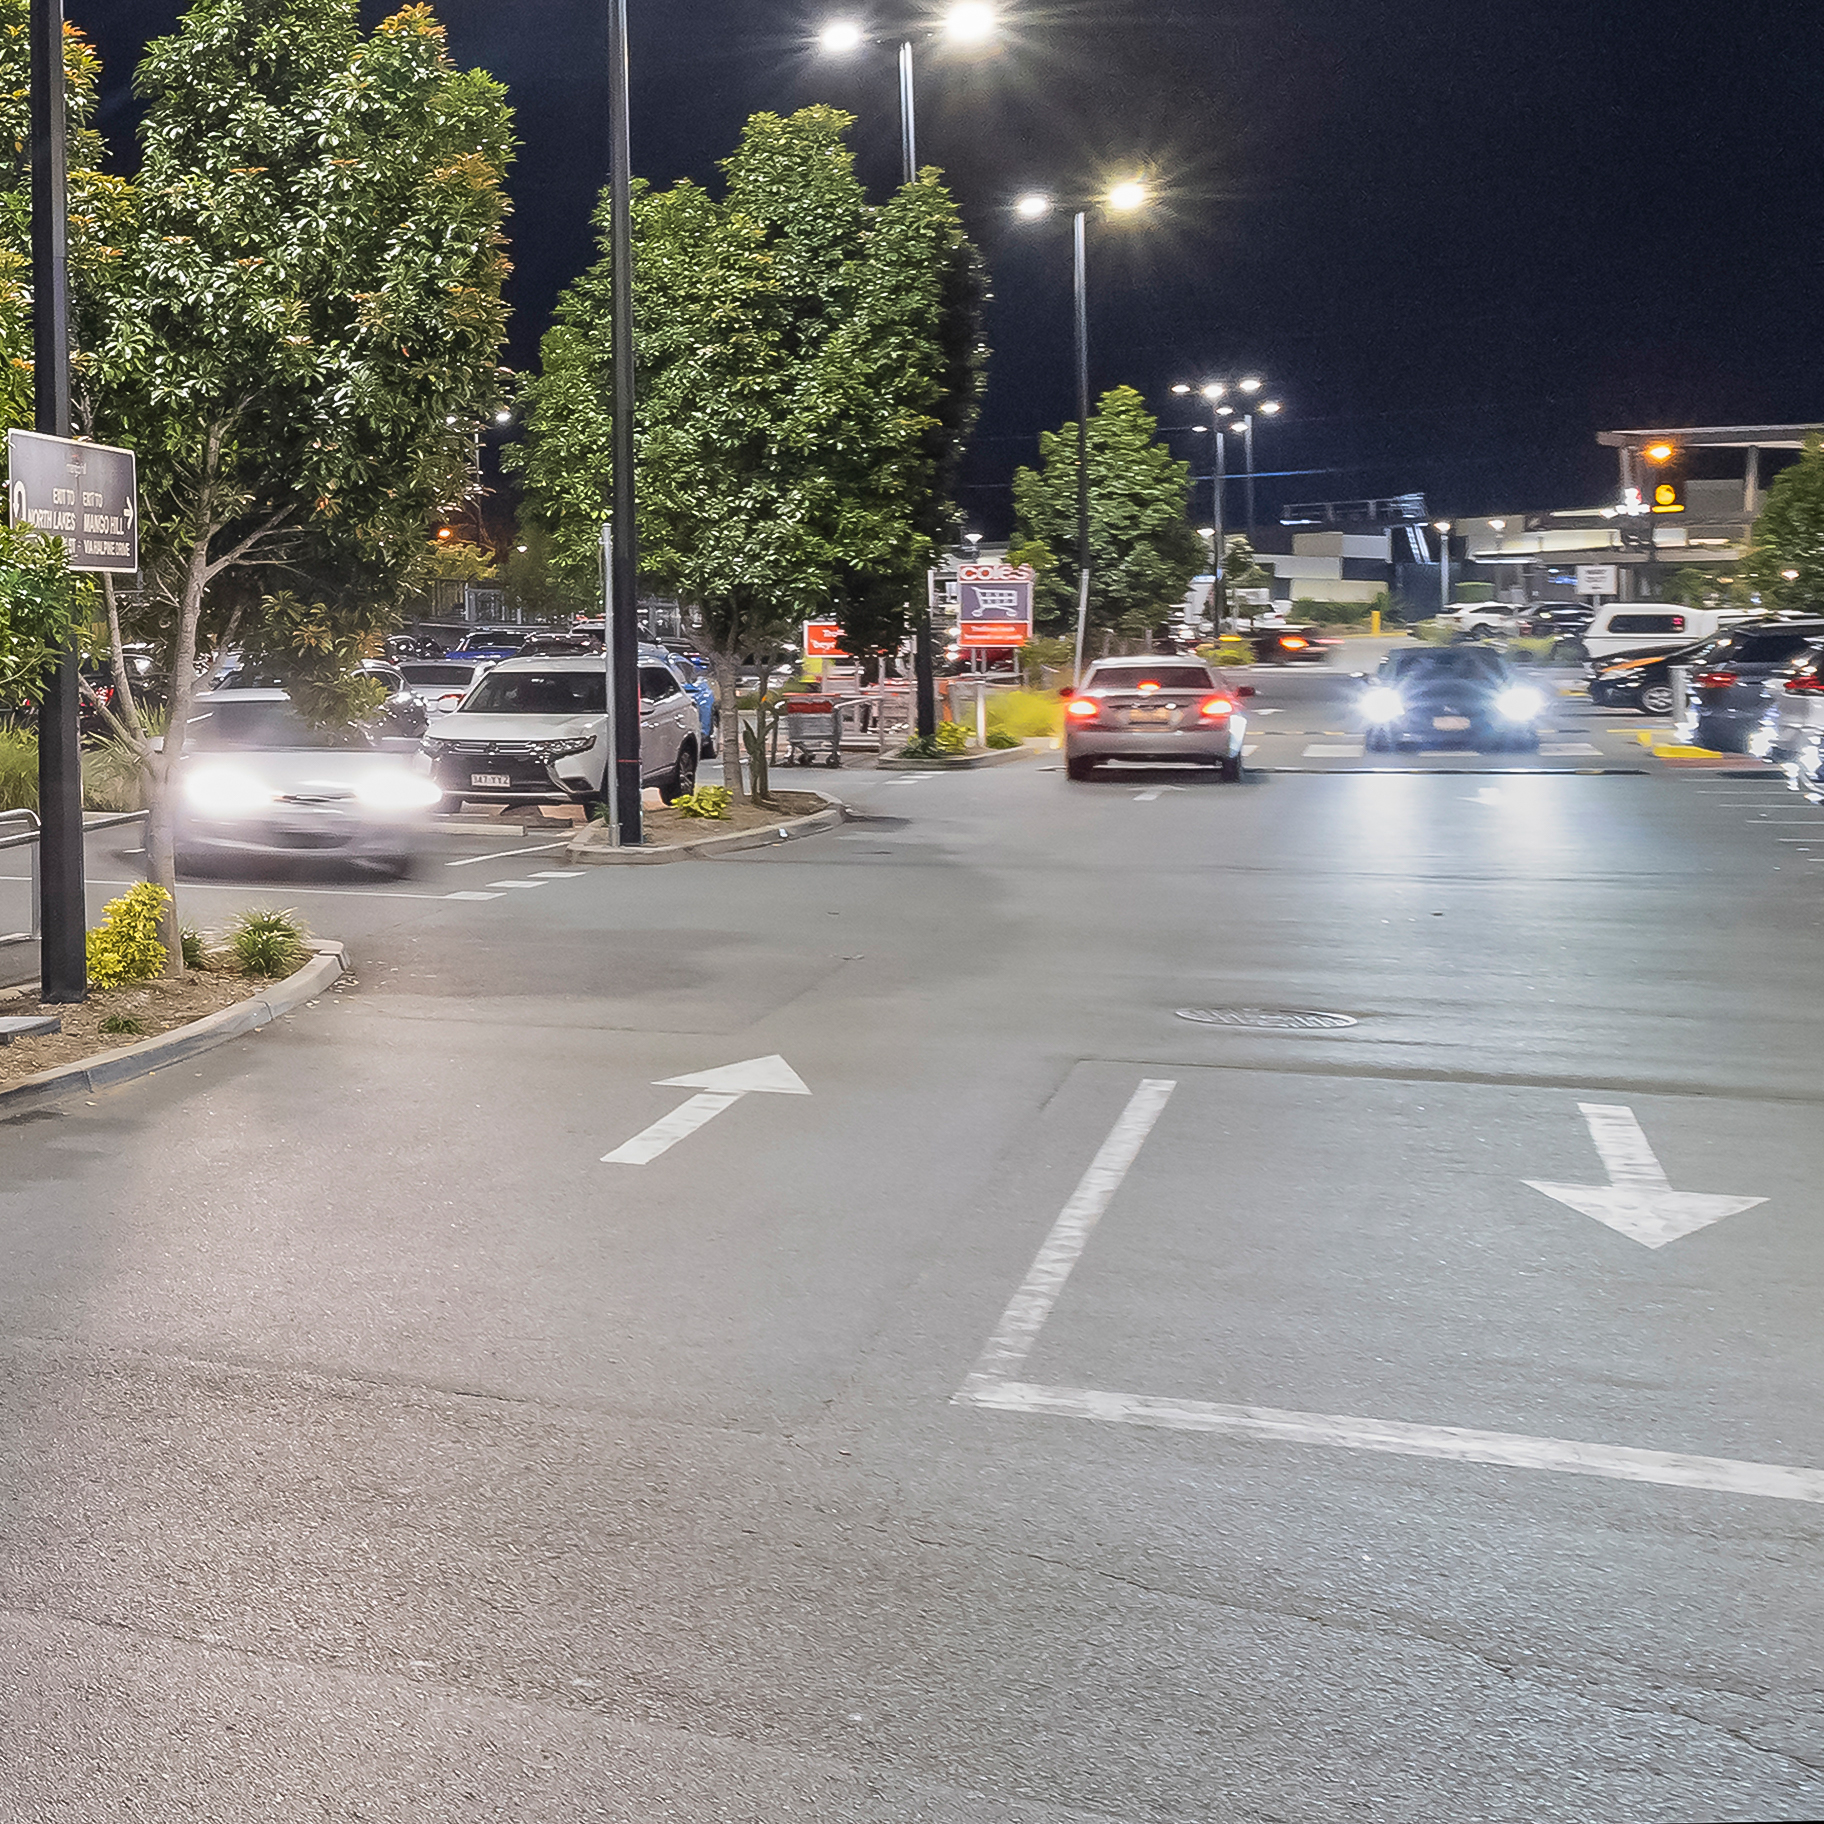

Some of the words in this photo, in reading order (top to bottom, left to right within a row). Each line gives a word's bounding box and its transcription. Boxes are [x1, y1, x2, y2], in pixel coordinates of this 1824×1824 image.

[28, 508, 52, 529] NORTH
[53, 511, 77, 531] LAKES
[83, 513, 109, 534] MANGO
[110, 516, 125, 535] HILL
